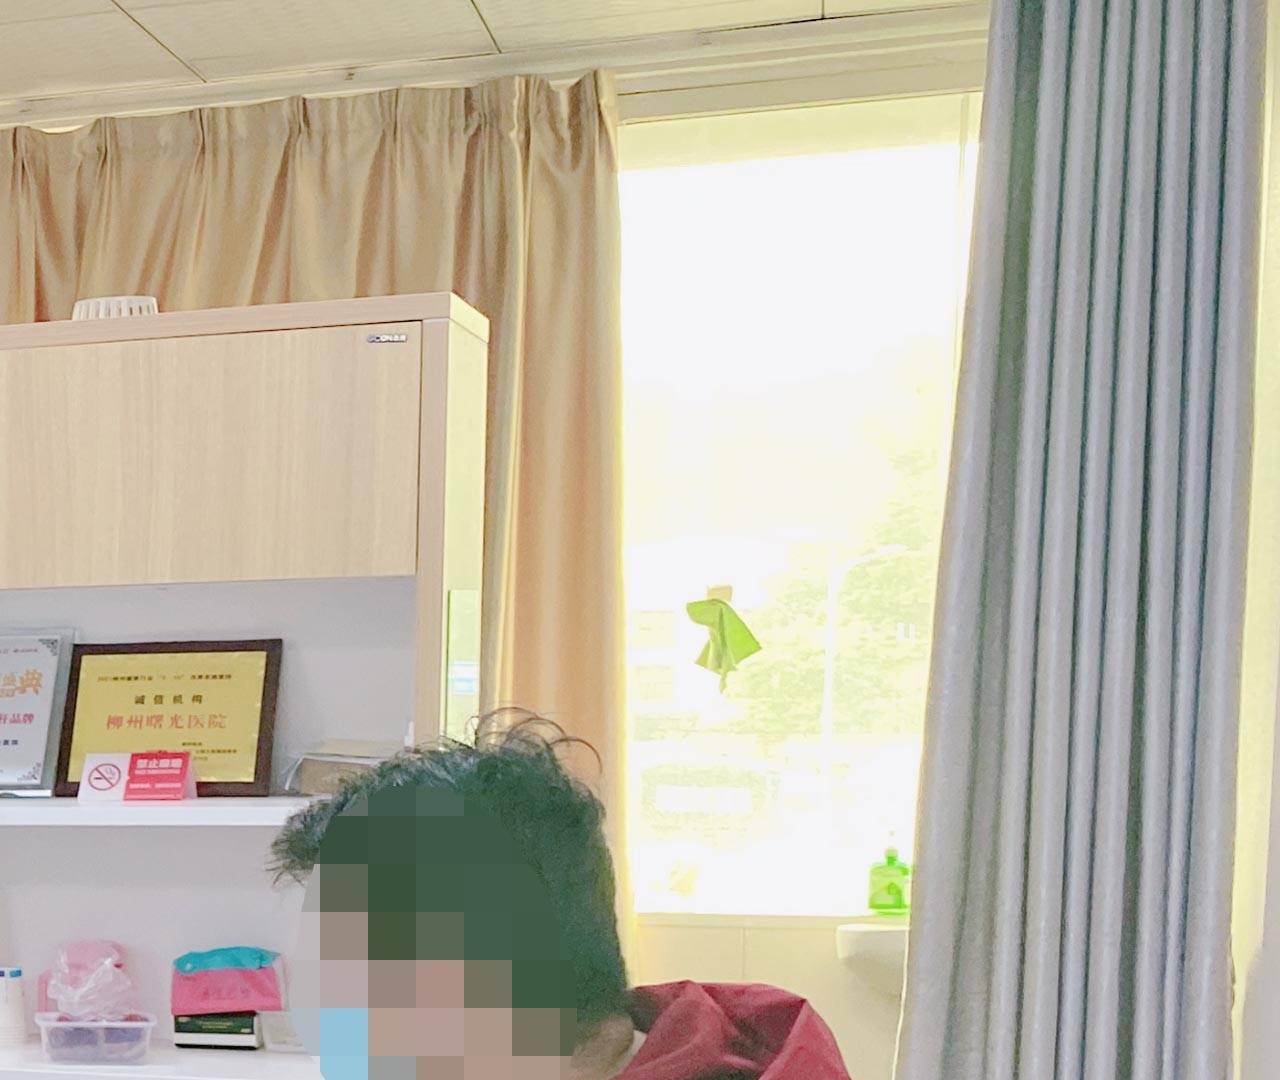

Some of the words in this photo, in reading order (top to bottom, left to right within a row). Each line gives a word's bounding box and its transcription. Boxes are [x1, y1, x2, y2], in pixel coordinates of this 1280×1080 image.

[106, 713, 227, 730] 柳州曙光医院
